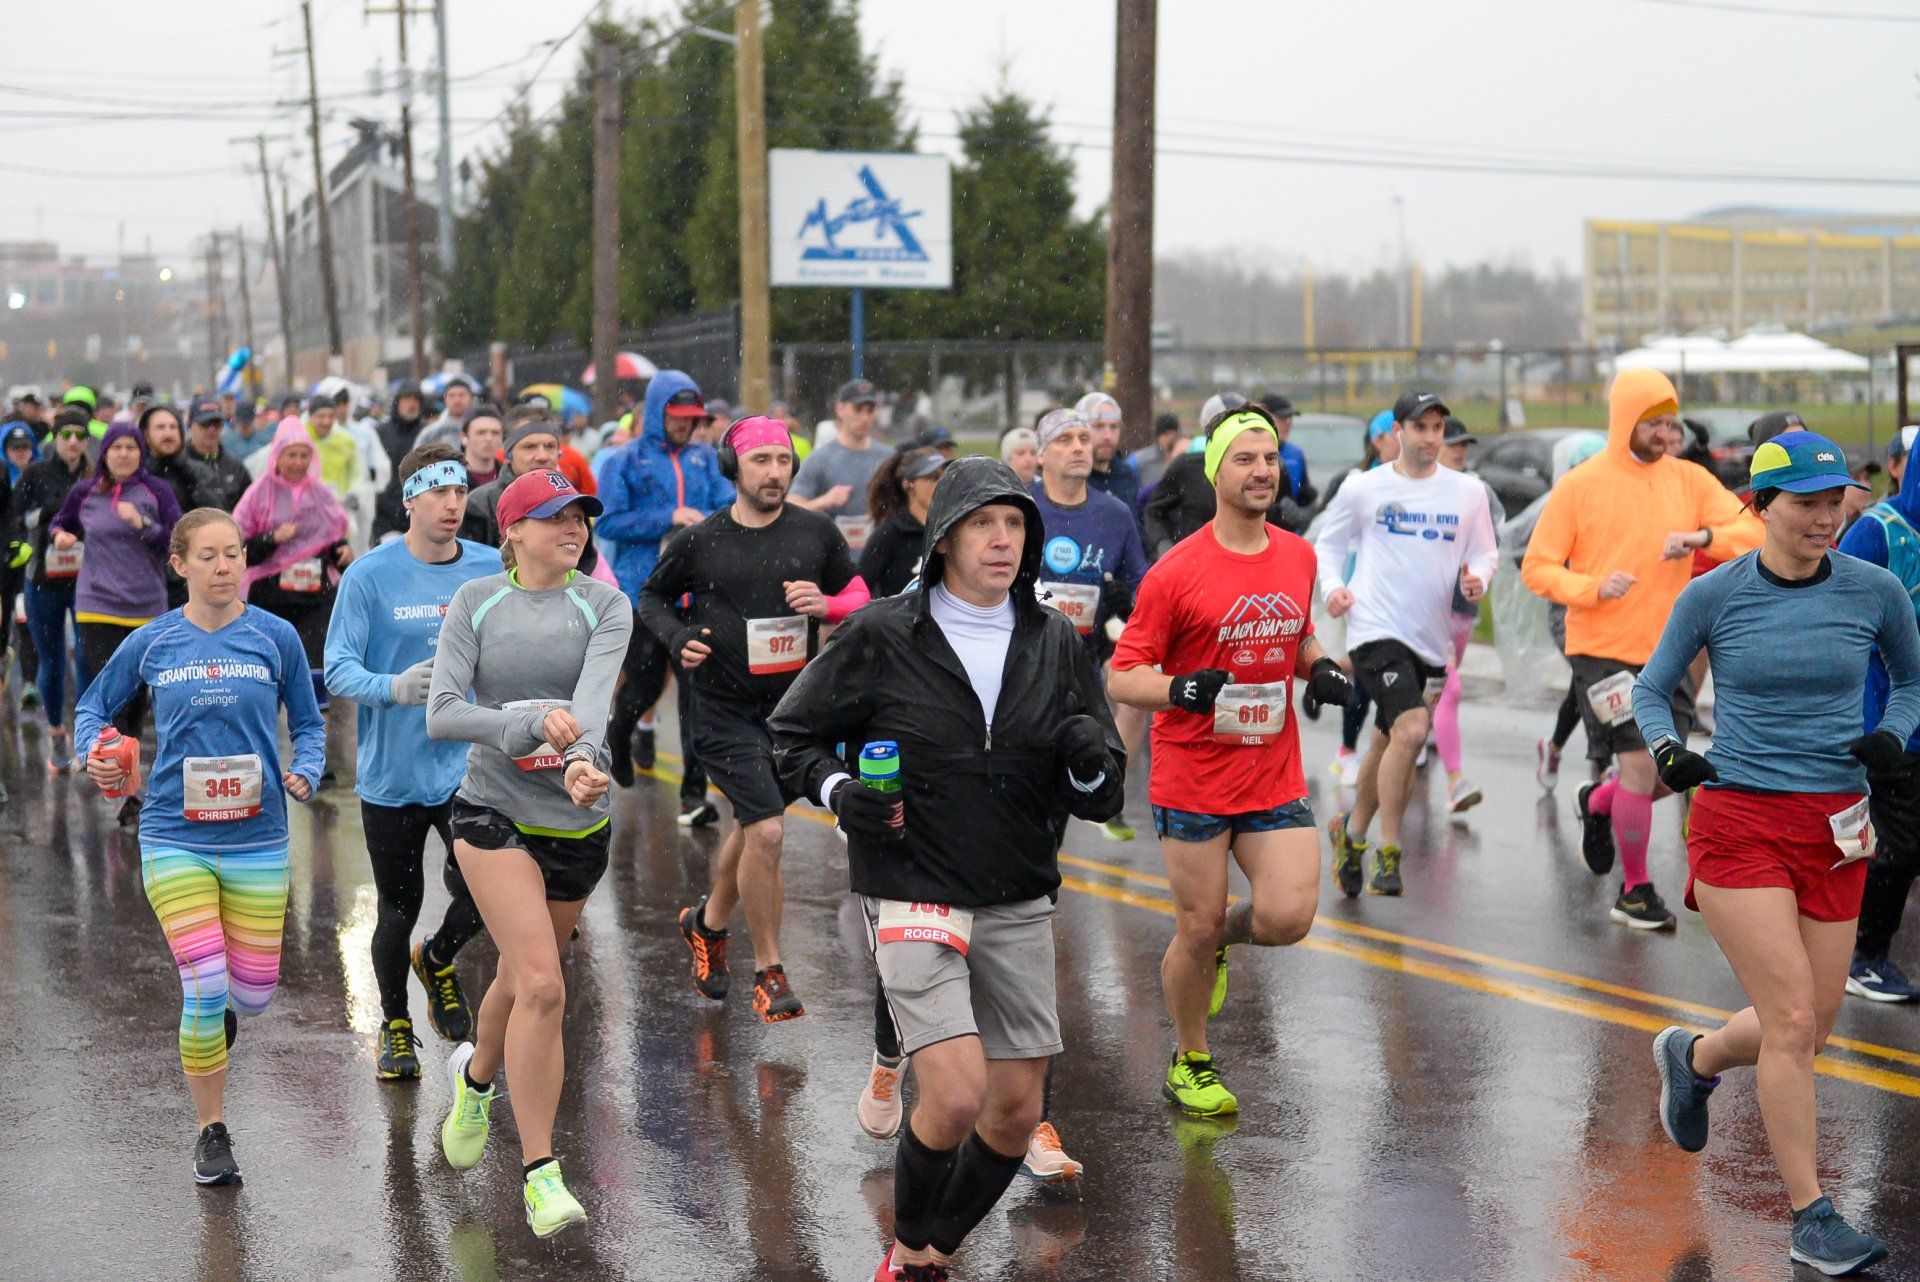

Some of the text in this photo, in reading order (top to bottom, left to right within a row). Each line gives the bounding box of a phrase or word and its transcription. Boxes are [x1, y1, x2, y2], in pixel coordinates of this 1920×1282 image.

[1436, 513, 1459, 525] RIVER
[394, 604, 440, 620] SCRANTON
[1217, 620, 1258, 643] BLACK
[769, 635, 795, 653] 972
[157, 665, 208, 686] SCRANTON
[220, 664, 270, 681] MARATHON
[191, 694, 239, 707] Geisinger
[1238, 703, 1269, 724] 616
[1241, 735, 1264, 744] NEIL
[205, 777, 242, 798] 345
[197, 808, 249, 820] CHRISTINE
[903, 928, 949, 942] ROGER
